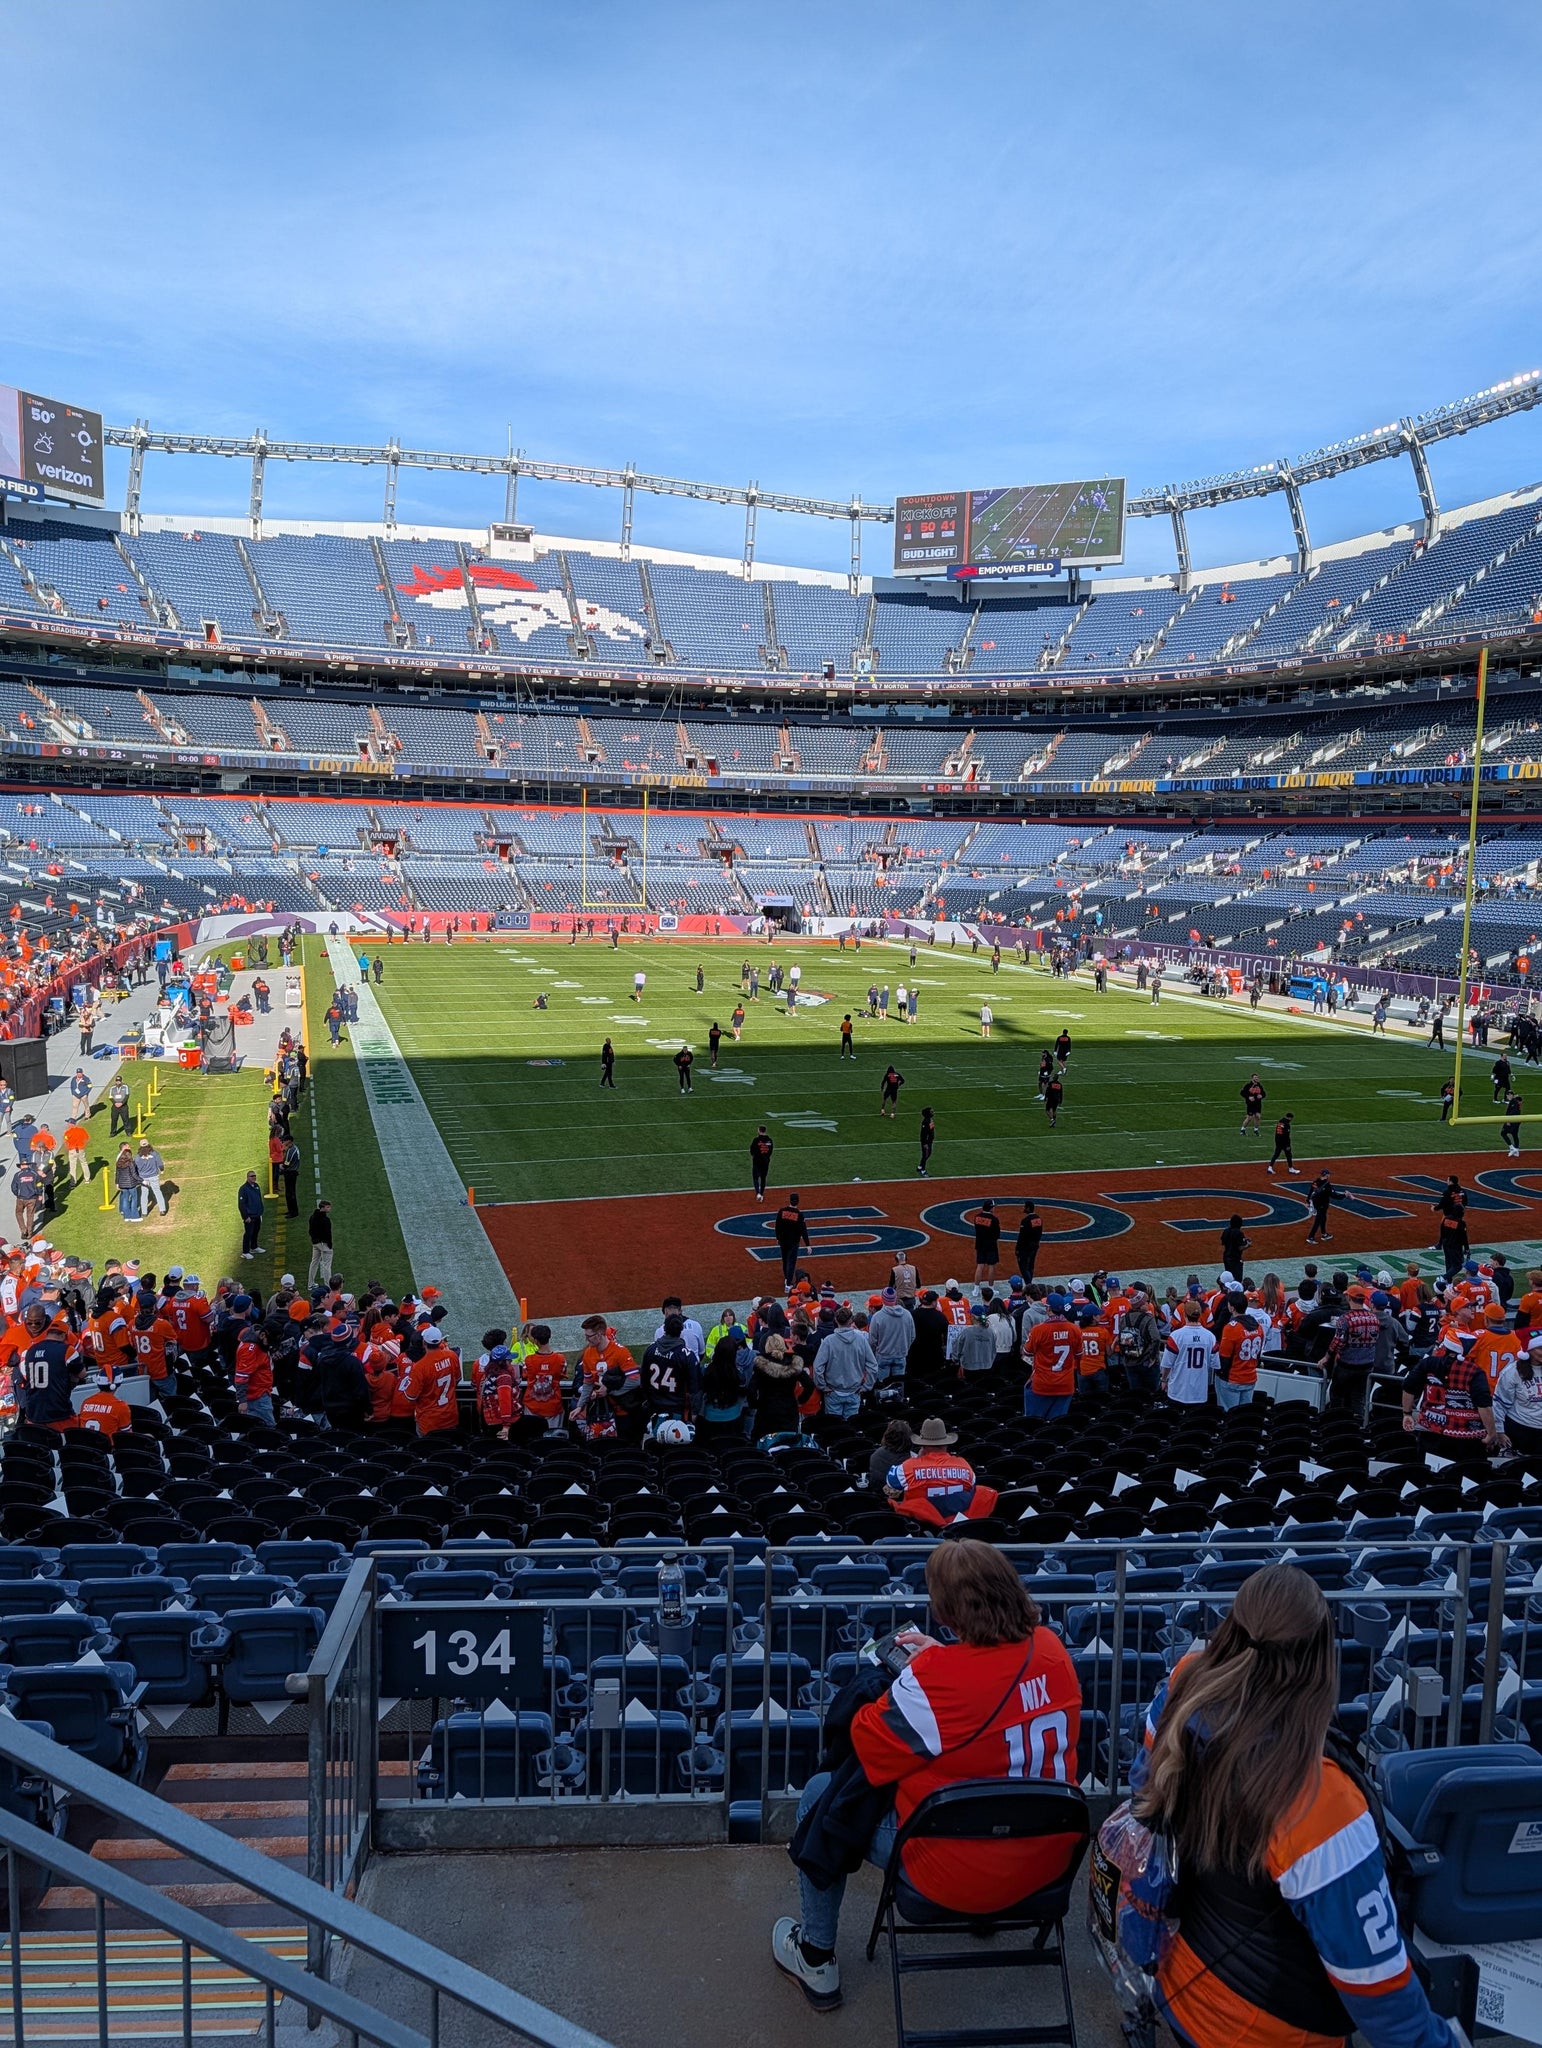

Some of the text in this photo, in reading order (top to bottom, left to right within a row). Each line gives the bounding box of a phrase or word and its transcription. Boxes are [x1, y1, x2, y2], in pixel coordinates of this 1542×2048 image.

[36, 462, 93, 488] verizon
[8, 481, 38, 496] FIELD
[903, 494, 956, 504] COUNTDOWN
[900, 506, 957, 522] KICKOFF
[920, 522, 936, 532] 50
[940, 520, 956, 530] 41
[903, 548, 955, 559] BUD LIGHT
[978, 562, 1054, 576] EMPOWER FIELD
[50, 626, 89, 636] GRADISHAR
[1489, 628, 1526, 639] SHANAHAN
[132, 636, 156, 644] MOSES
[1433, 638, 1456, 647] BAILEY
[204, 644, 240, 652] THOMPSON
[332, 654, 354, 662] PHIPPS
[1335, 652, 1354, 660] LYNCH
[477, 664, 500, 672] TAYLOR
[1282, 660, 1302, 668] REEVES
[480, 700, 496, 708] BUD
[518, 703, 560, 711] CHAMPIONS
[78, 748, 88, 757] 16
[110, 750, 122, 759] 22
[178, 754, 199, 763] 90:00
[206, 756, 216, 764] 25
[266, 758, 300, 769] MORE
[353, 761, 395, 774] MORE
[454, 766, 486, 778] MORE
[670, 775, 708, 787] MORE
[761, 780, 790, 790] MORE
[1242, 776, 1270, 790] MORE
[1277, 772, 1354, 788] (JOY) MORE
[937, 784, 951, 792] 50
[964, 784, 978, 792] 41
[1041, 782, 1074, 792] MORE
[1081, 781, 1156, 792] (JOY) MORE
[178, 827, 203, 835] ARROW
[370, 832, 396, 840] ARROW
[1234, 957, 1272, 979] HIGH
[179, 1052, 187, 1063] G
[176, 1309, 187, 1330] 2
[952, 1307, 966, 1325] 15
[1428, 1318, 1436, 1332] 2
[90, 1331, 104, 1352] 10
[1053, 1331, 1068, 1340] ELWAY
[135, 1334, 151, 1354] 18
[1082, 1340, 1100, 1356] 18
[34, 1350, 46, 1358] NIX
[1052, 1345, 1070, 1372] 7
[1186, 1347, 1204, 1368] 10
[434, 1358, 451, 1372] ELWAY
[28, 1361, 49, 1388] 10
[650, 1362, 677, 1392] 24
[436, 1374, 452, 1406] 7
[82, 1403, 107, 1413] SURTAIN
[1445, 1410, 1480, 1418] BRONCOS
[914, 1467, 970, 1480] MECKLENBURG
[413, 1629, 516, 1675] 134
[1019, 1674, 1052, 1713] NIX
[1004, 1710, 1069, 1780] 10
